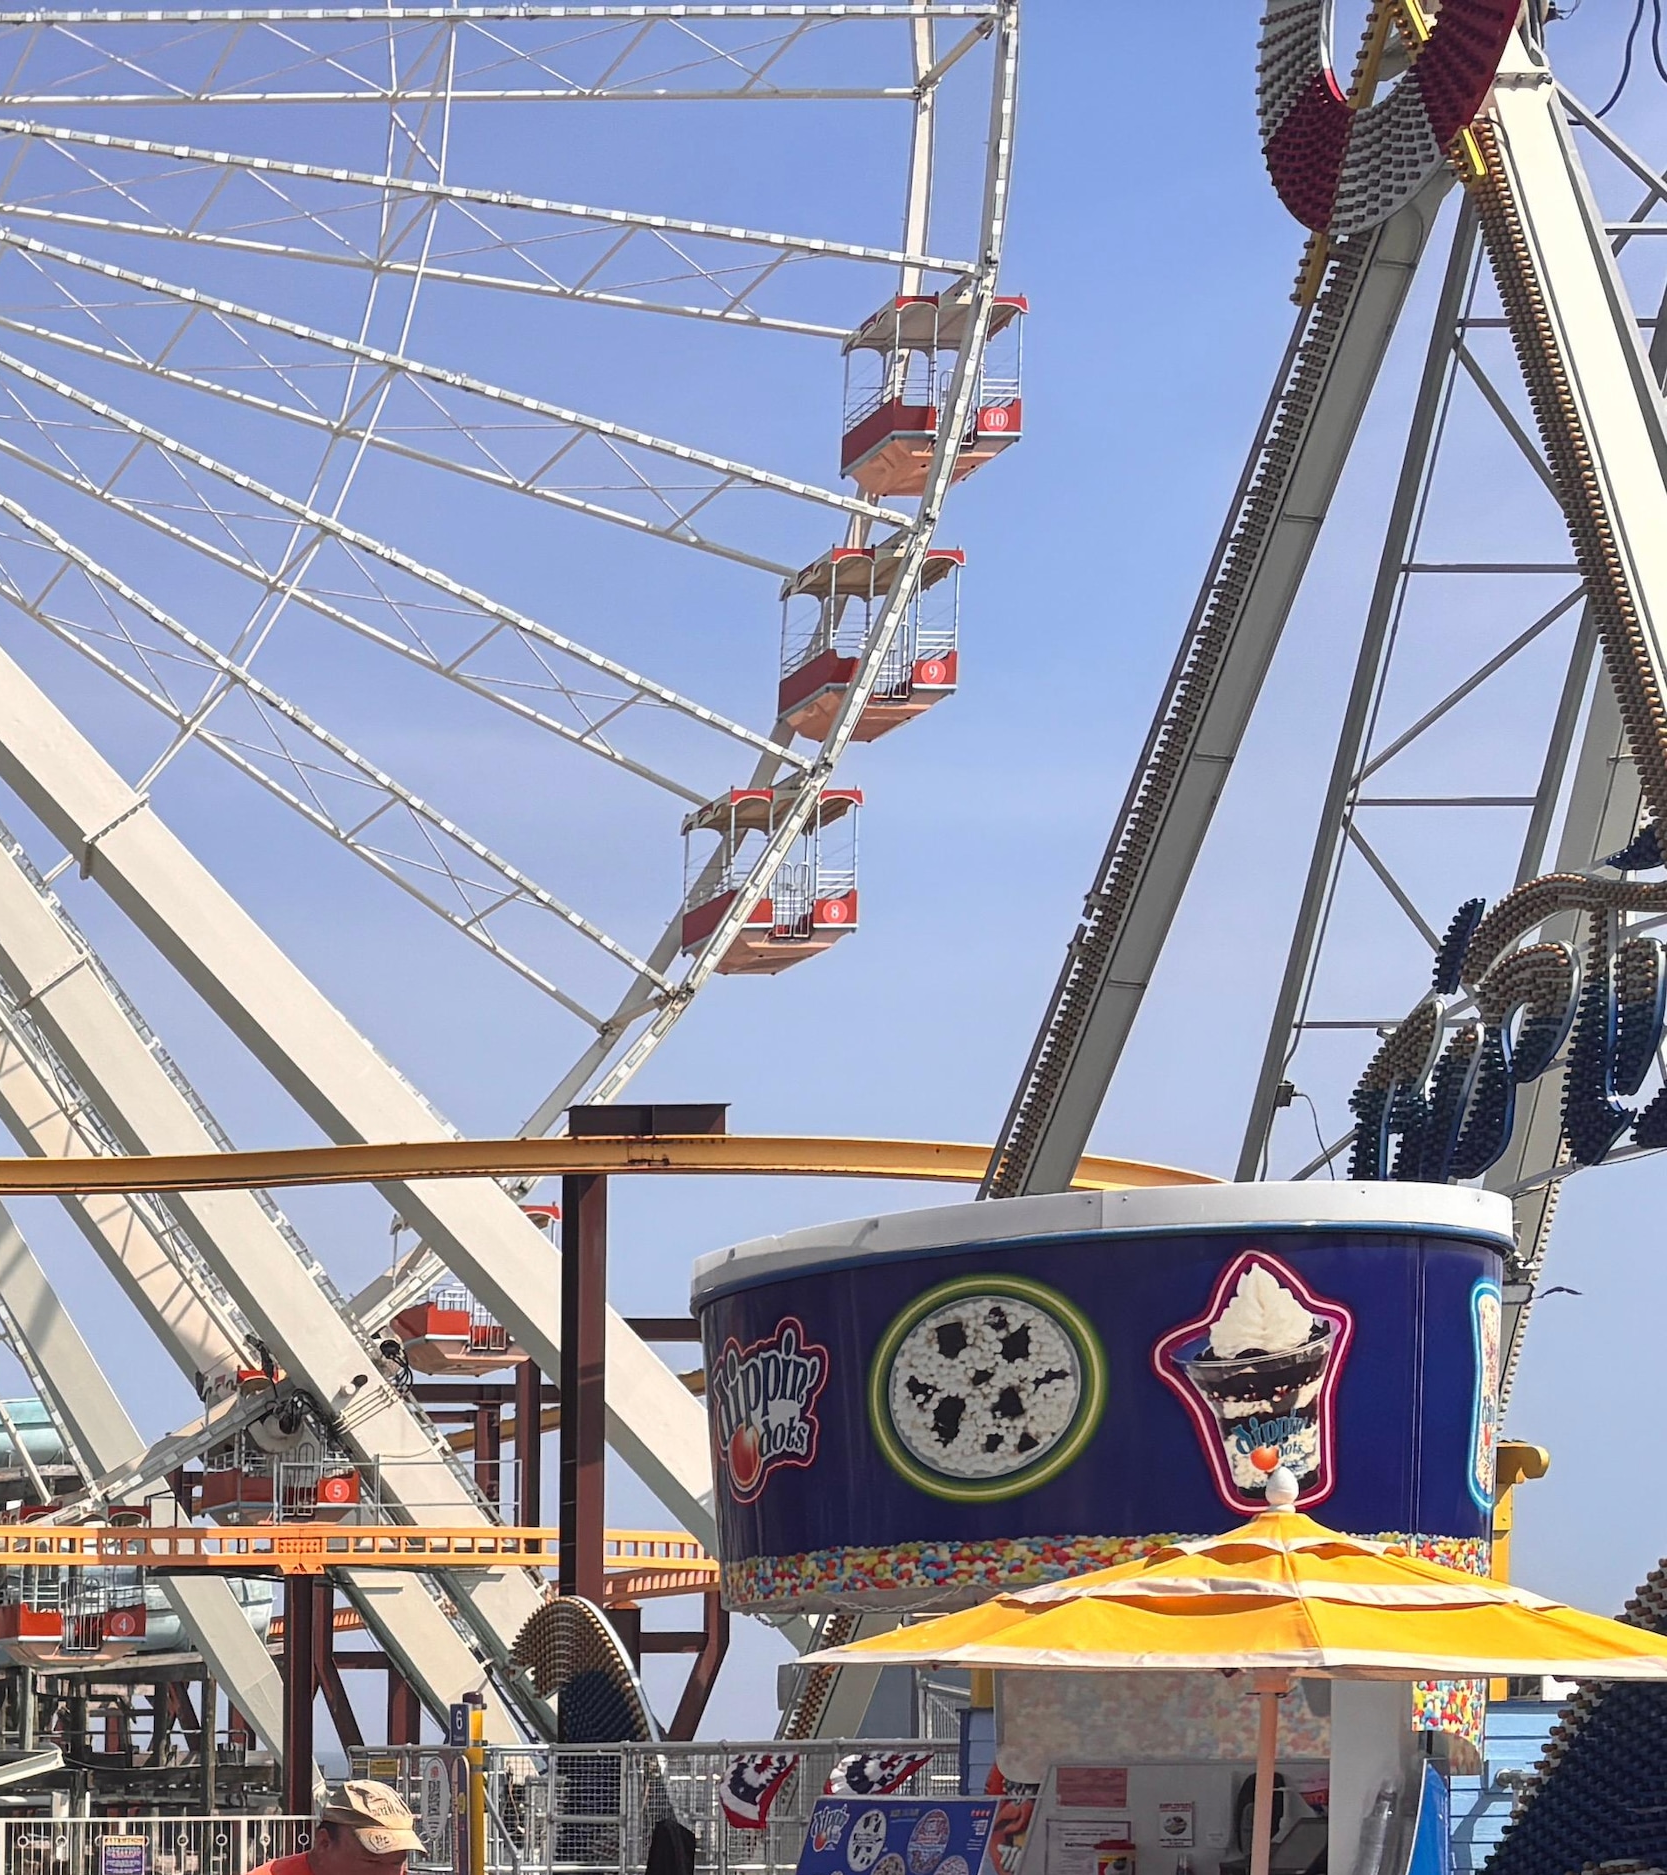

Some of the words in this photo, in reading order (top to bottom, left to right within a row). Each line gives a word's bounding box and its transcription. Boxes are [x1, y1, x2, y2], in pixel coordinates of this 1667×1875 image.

[988, 412, 1005, 427] 10
[928, 665, 938, 679] 9
[830, 905, 840, 919] 8
[757, 1415, 810, 1458] dots
[331, 1484, 343, 1498] 5
[117, 1617, 128, 1632] 4
[455, 1710, 464, 1731] 6
